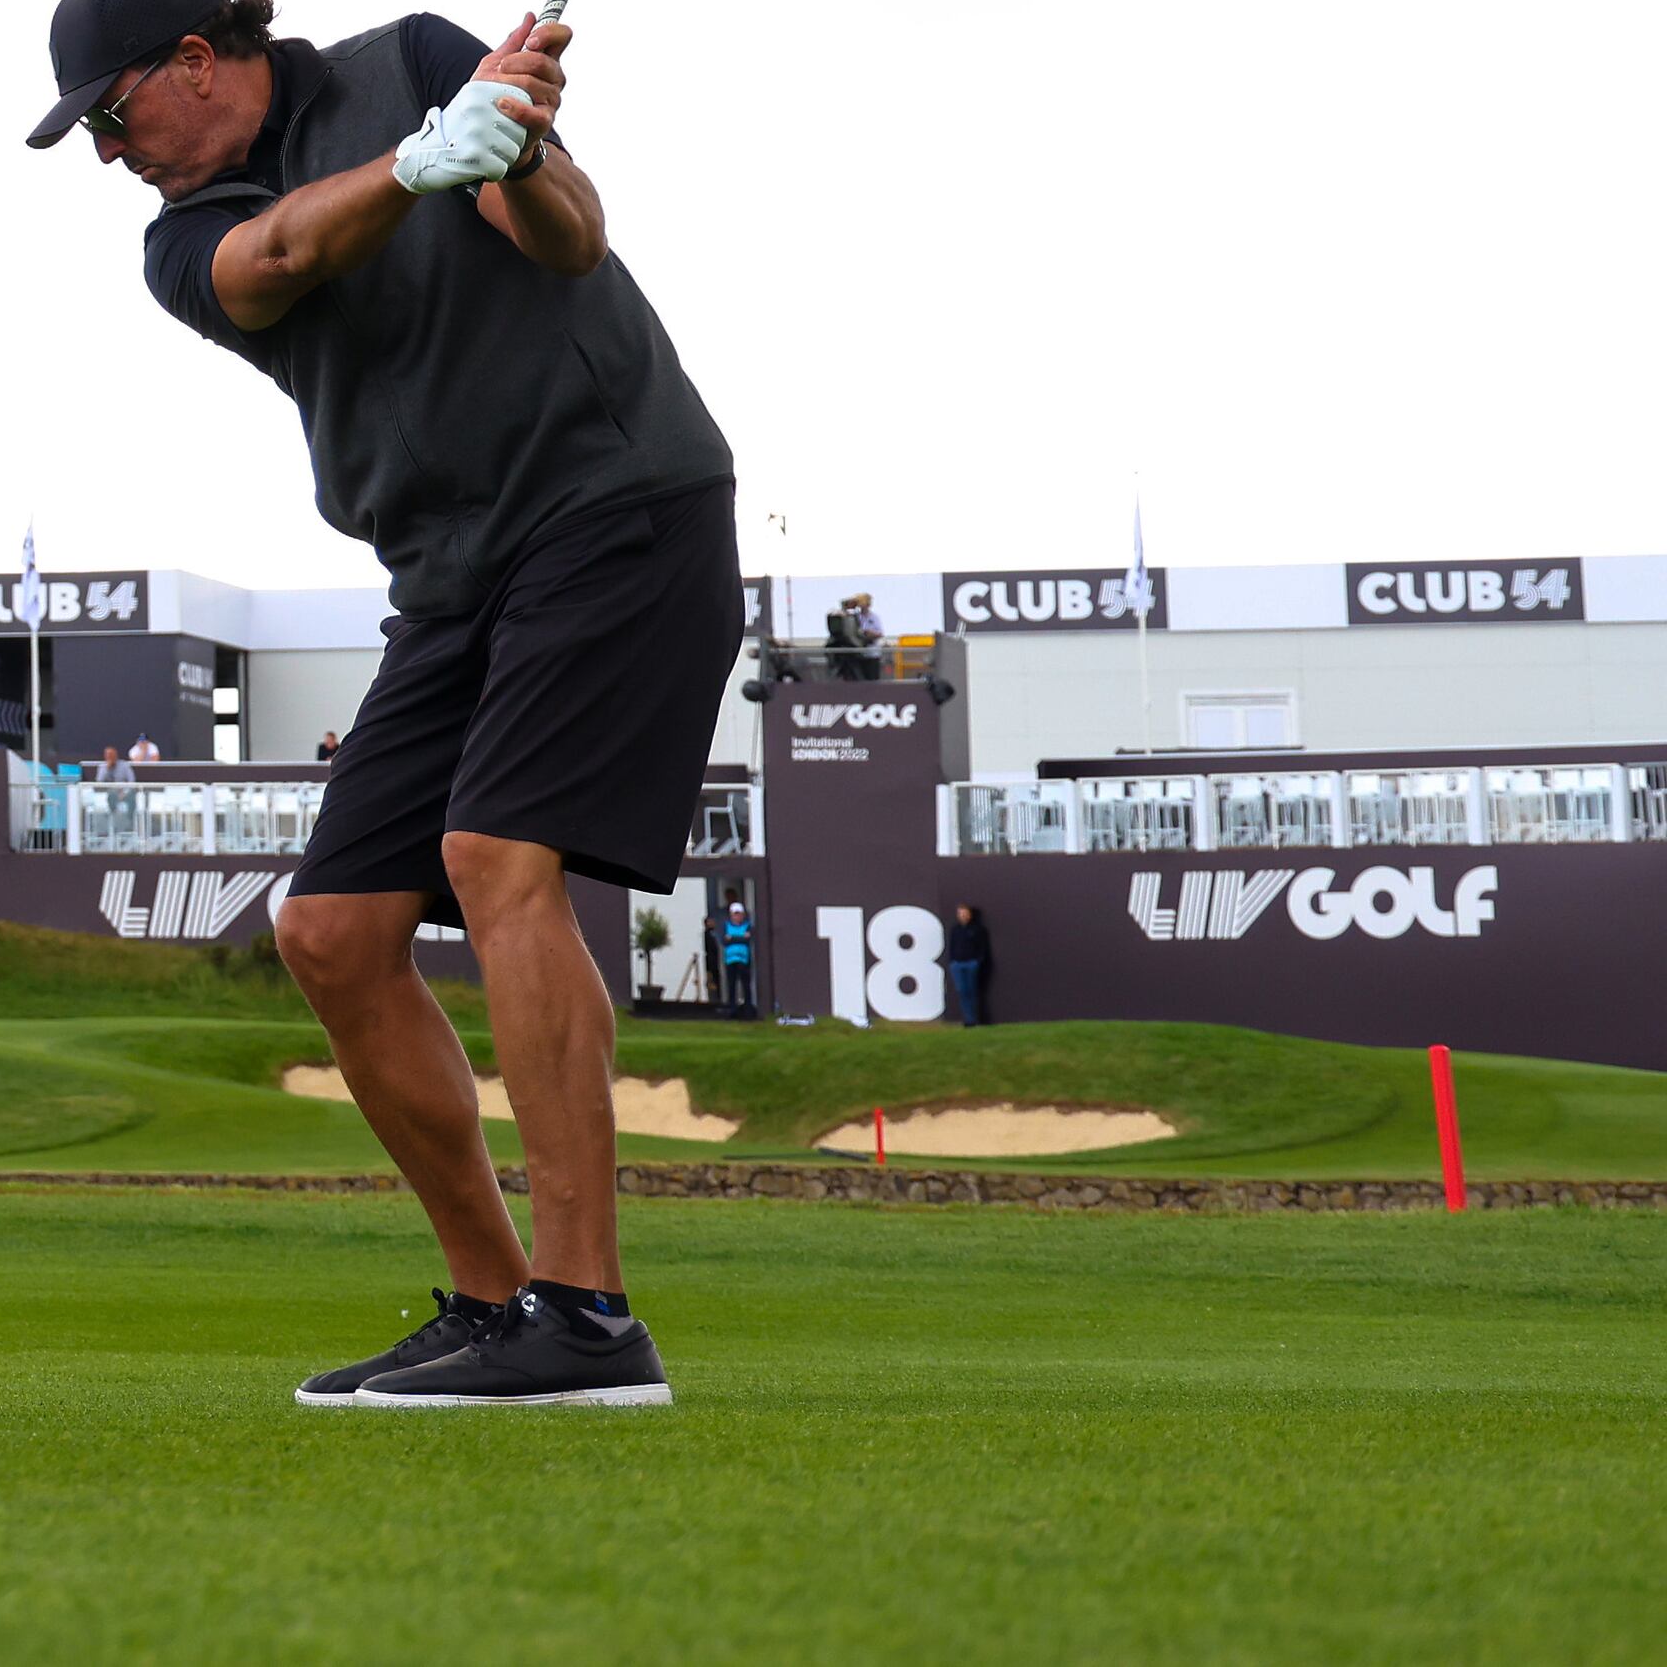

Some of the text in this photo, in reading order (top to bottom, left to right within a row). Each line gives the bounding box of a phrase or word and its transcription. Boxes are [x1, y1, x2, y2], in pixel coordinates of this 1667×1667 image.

[85, 581, 138, 621] 54
[953, 580, 1093, 623] CLUB
[1357, 569, 1571, 614] CLUB 54
[790, 703, 917, 729] LIV GOLF
[99, 870, 277, 939] LIV
[1128, 865, 1499, 941] LIV GOLF
[816, 905, 947, 1021] 18
